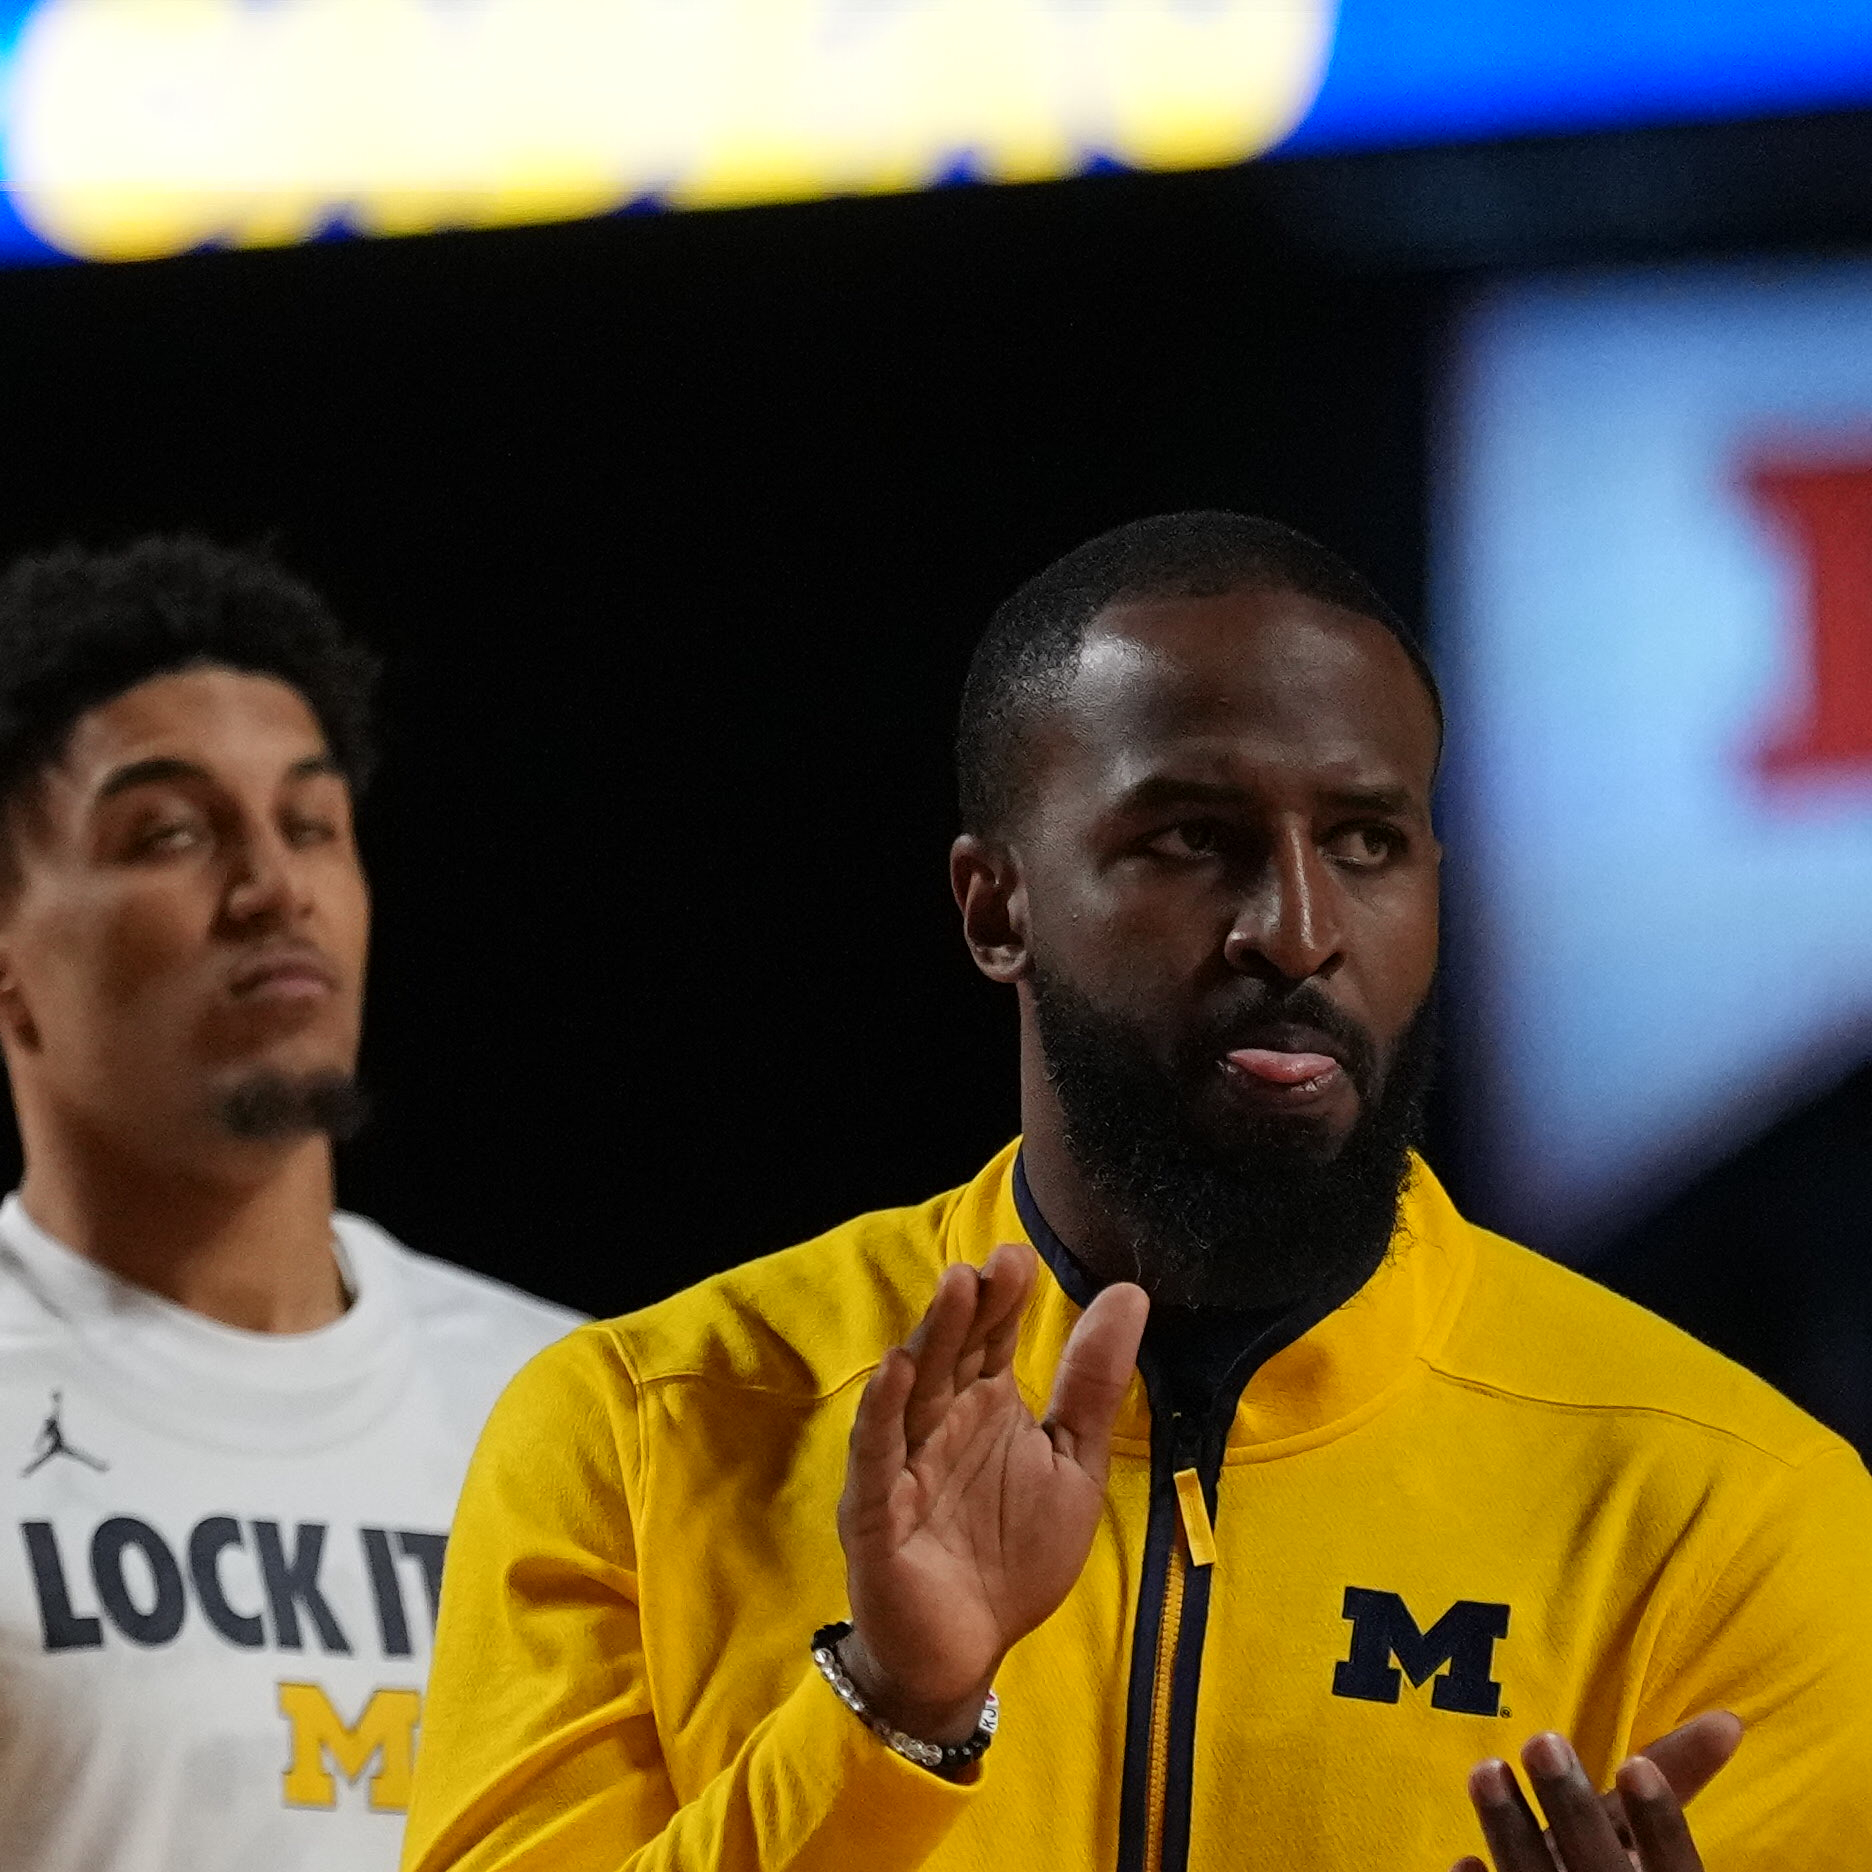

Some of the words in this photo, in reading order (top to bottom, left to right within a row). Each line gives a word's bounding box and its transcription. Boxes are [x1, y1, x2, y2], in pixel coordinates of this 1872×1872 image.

[19, 1513, 352, 1656] LOCK
[1332, 1586, 1510, 1717] M
[276, 1680, 422, 1814] M
